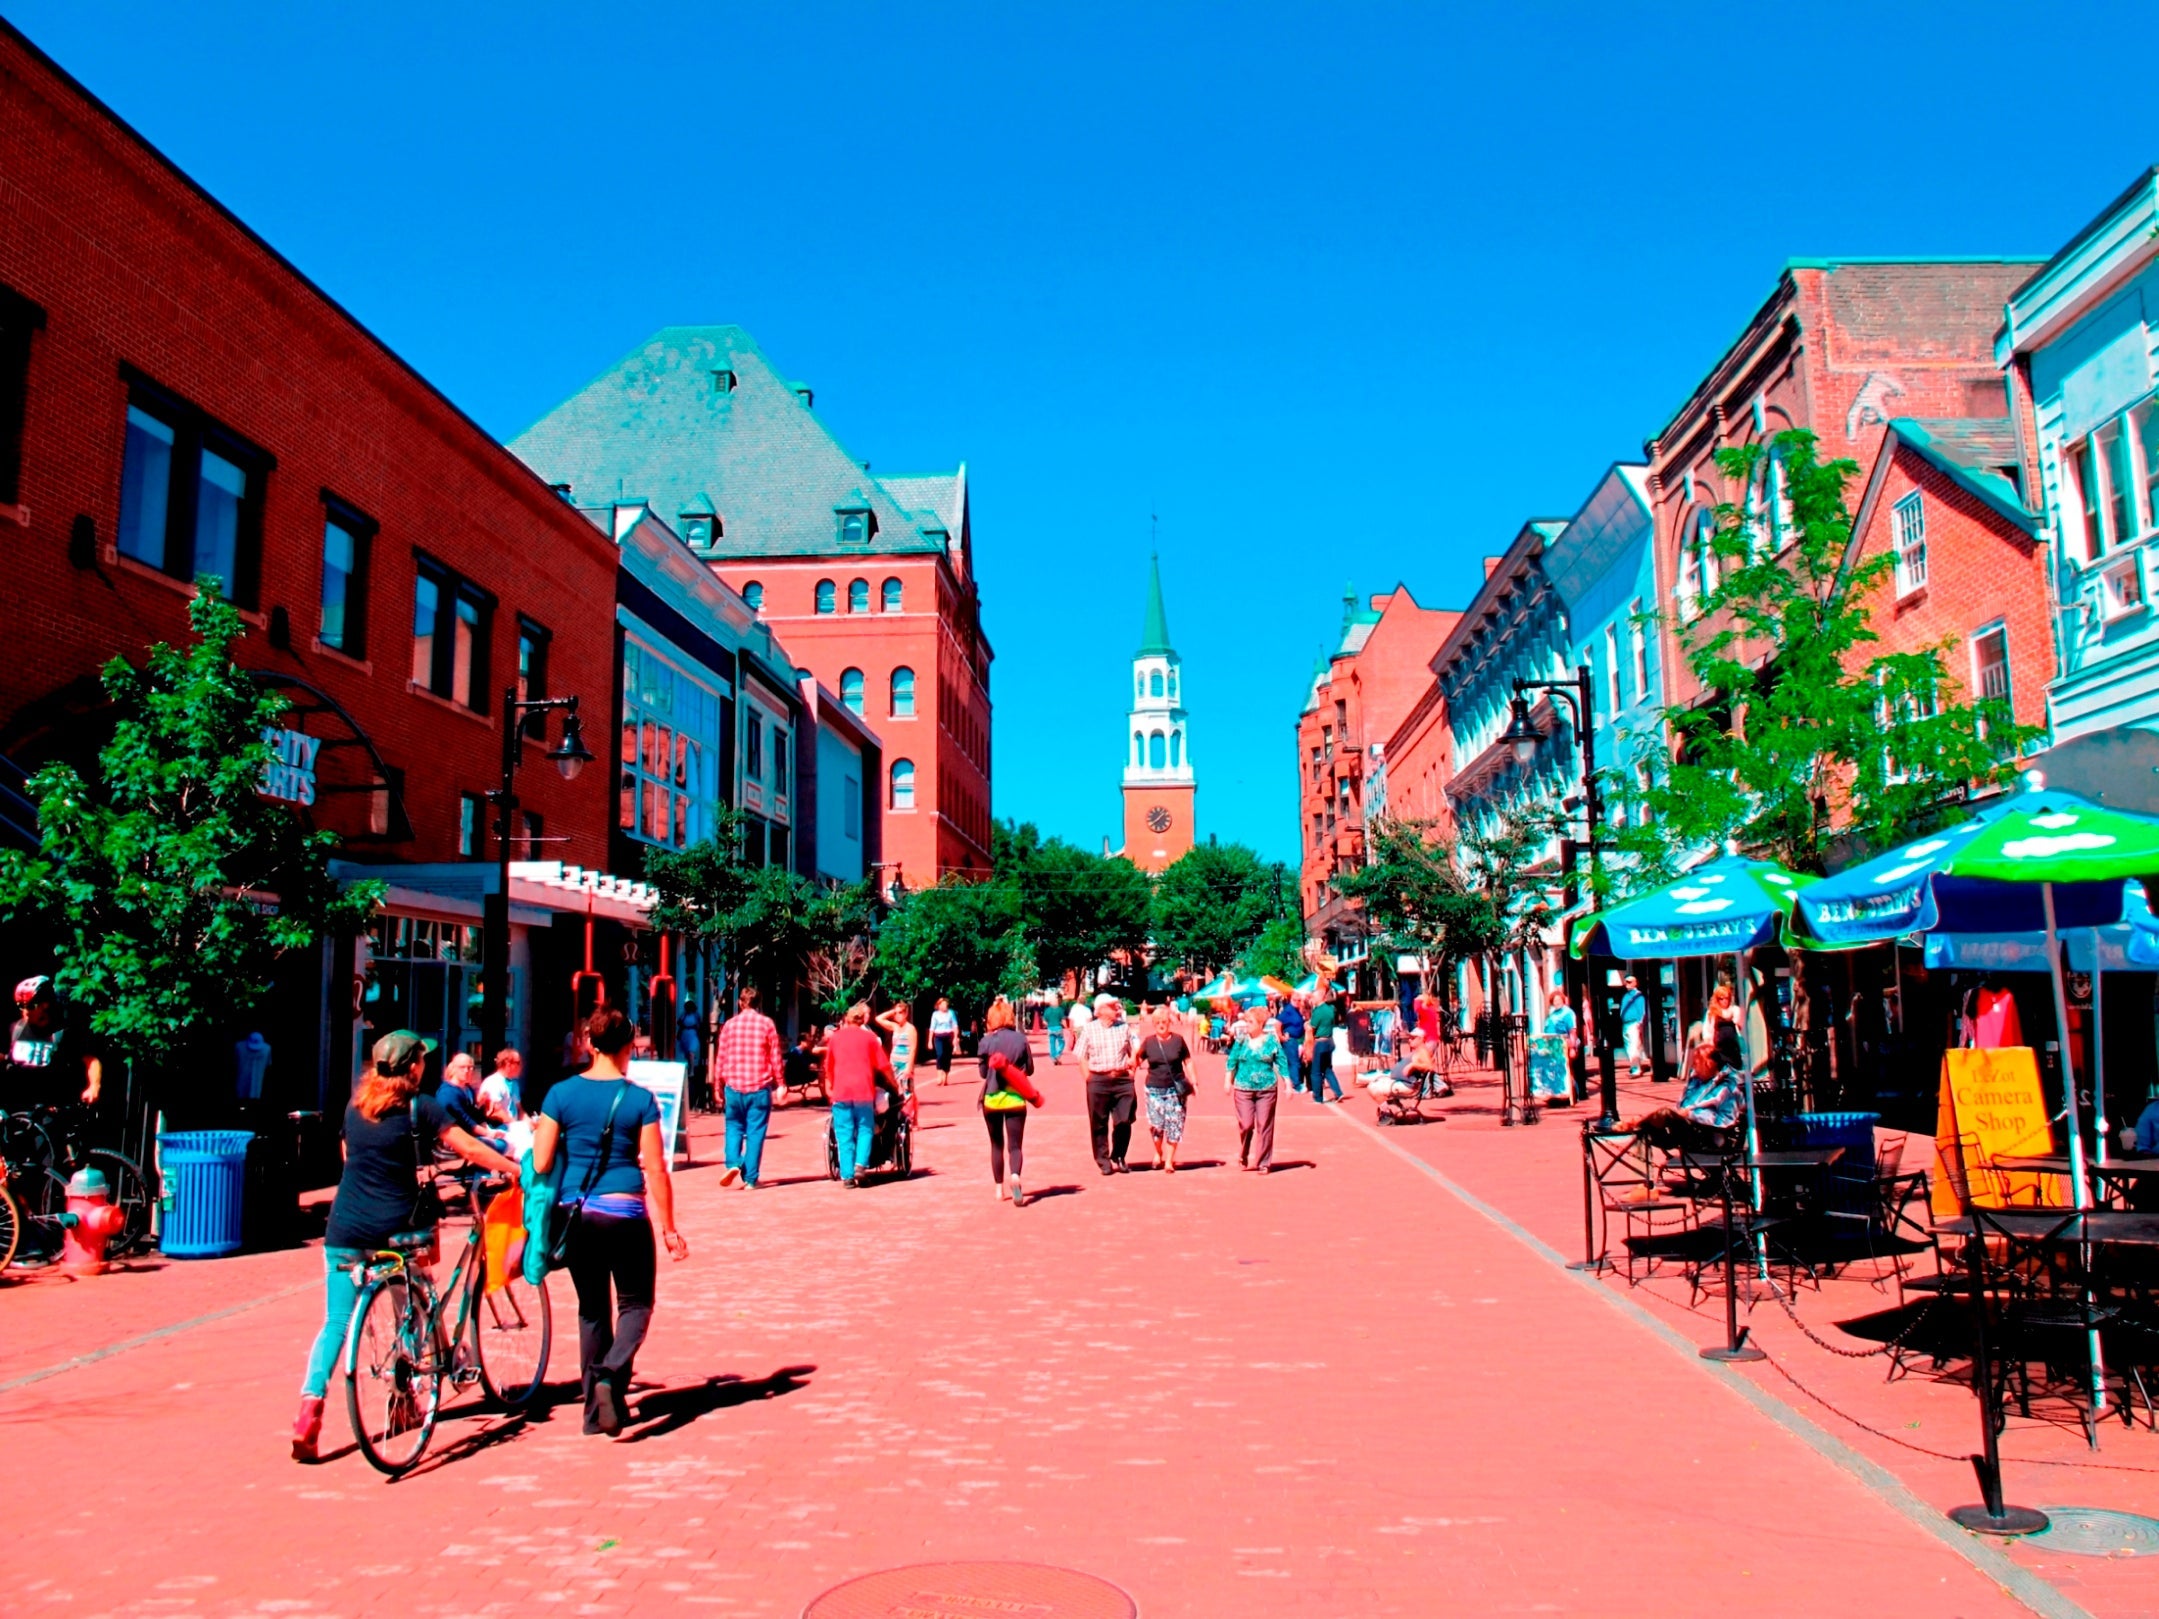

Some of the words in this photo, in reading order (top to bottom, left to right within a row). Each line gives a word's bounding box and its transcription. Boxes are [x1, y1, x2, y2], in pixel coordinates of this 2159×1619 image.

[254, 762, 317, 806] ORTS
[1817, 902, 1854, 922] BEN
[1629, 928, 1668, 944] BEN
[1683, 918, 1758, 940] JERRY'S
[1957, 1087, 2034, 1106] Camera
[1975, 1111, 2027, 1135] Shop
